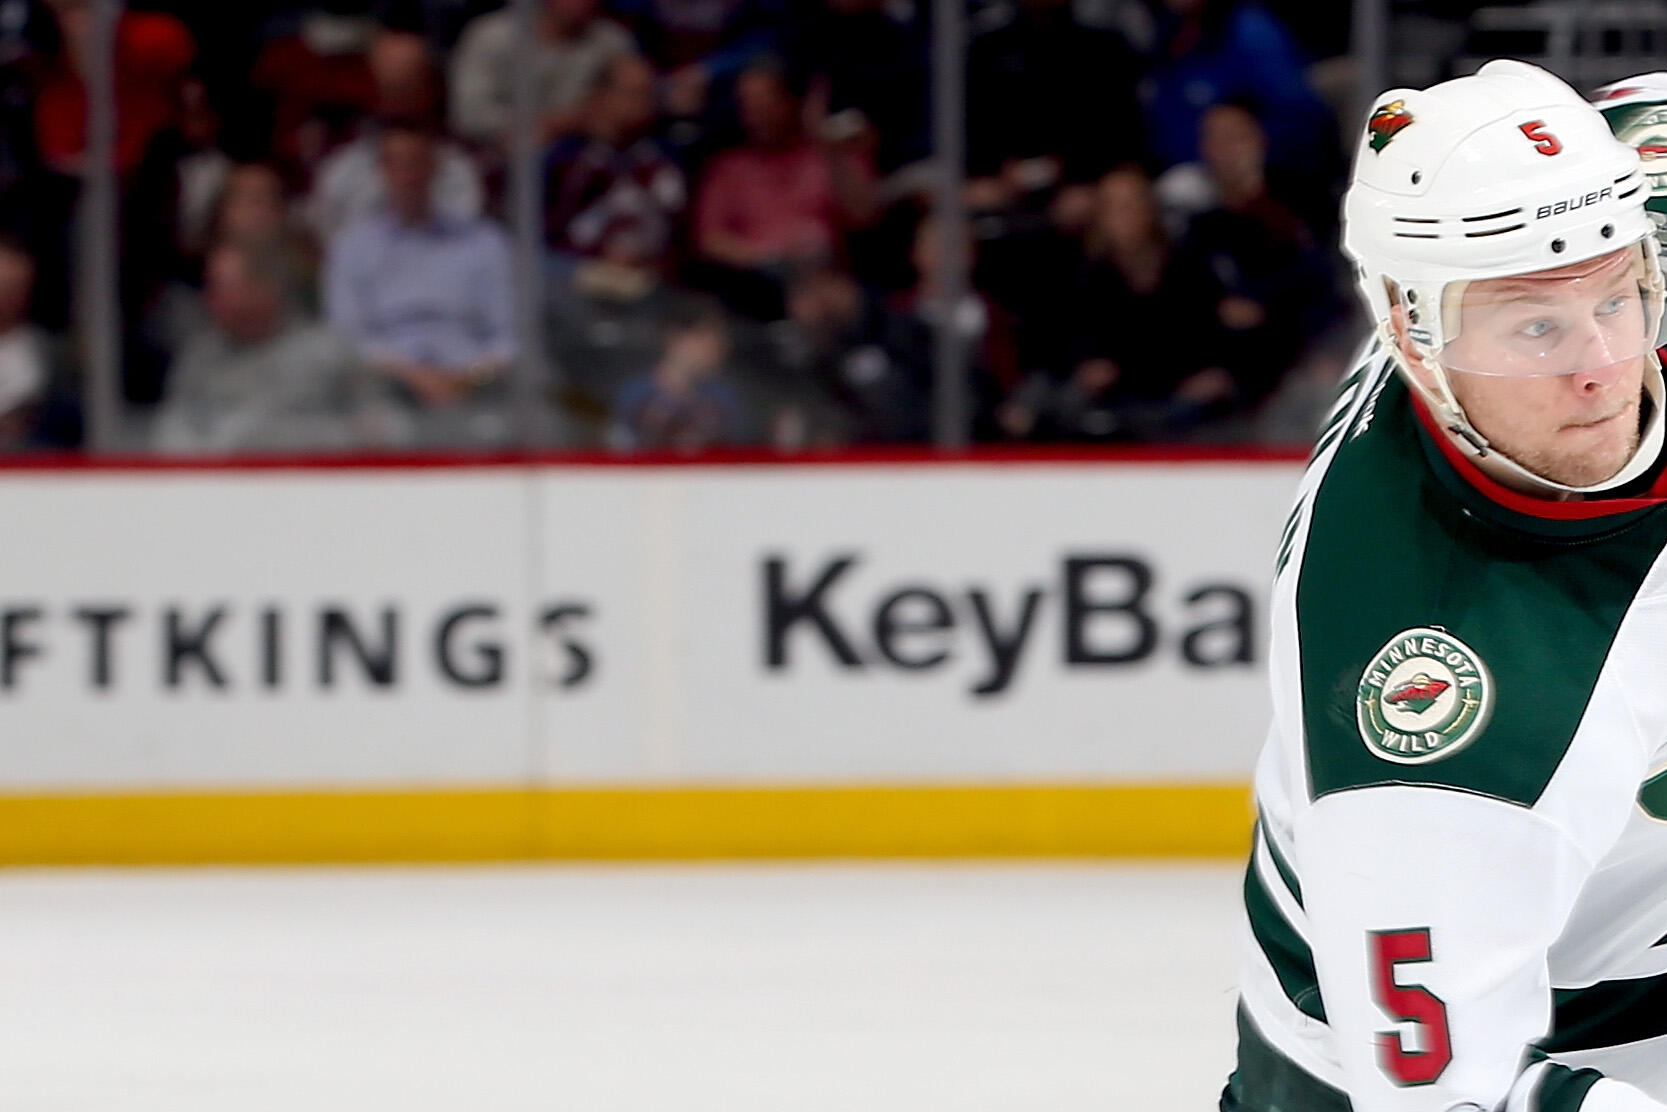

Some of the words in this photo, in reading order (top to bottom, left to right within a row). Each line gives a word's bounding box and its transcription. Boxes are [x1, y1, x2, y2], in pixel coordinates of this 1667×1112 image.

[1519, 120, 1563, 157] 5
[1535, 185, 1616, 220] BAUER
[0, 604, 594, 690] FTKINGS
[759, 550, 1256, 698] KeyBa
[1367, 637, 1481, 689] MINNESOTA
[1380, 728, 1440, 752] WILD
[1366, 925, 1453, 1089] 5
